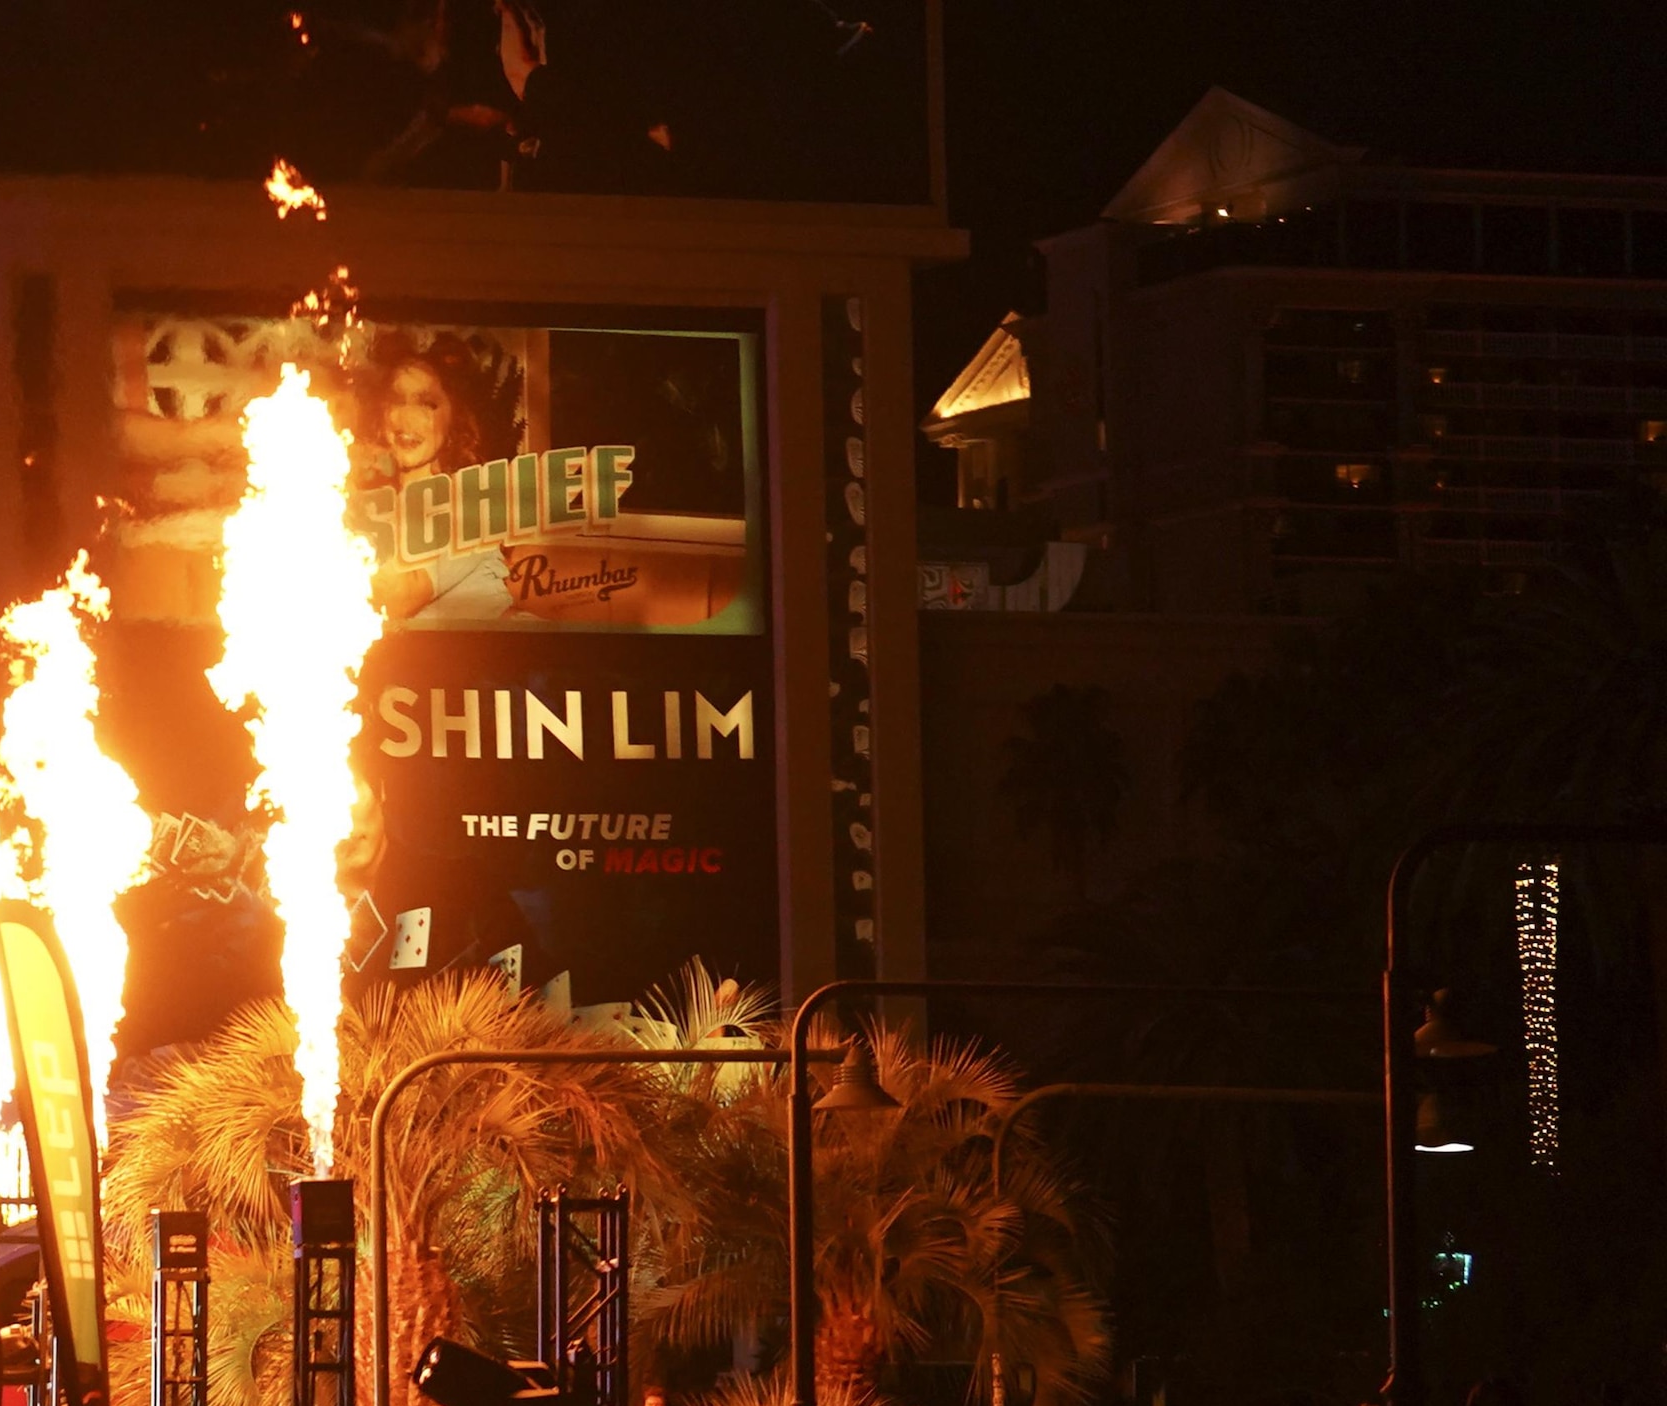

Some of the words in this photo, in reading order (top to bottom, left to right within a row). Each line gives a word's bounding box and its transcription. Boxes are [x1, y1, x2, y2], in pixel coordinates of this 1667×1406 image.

[357, 444, 636, 572] SCHIEF
[509, 554, 638, 601] Rhumbar
[379, 687, 584, 761] SHIN
[612, 690, 754, 760] LIM
[462, 815, 518, 837] THE
[526, 813, 672, 840] FUTURE
[556, 849, 594, 870] OF
[604, 848, 723, 874] MAGIC
